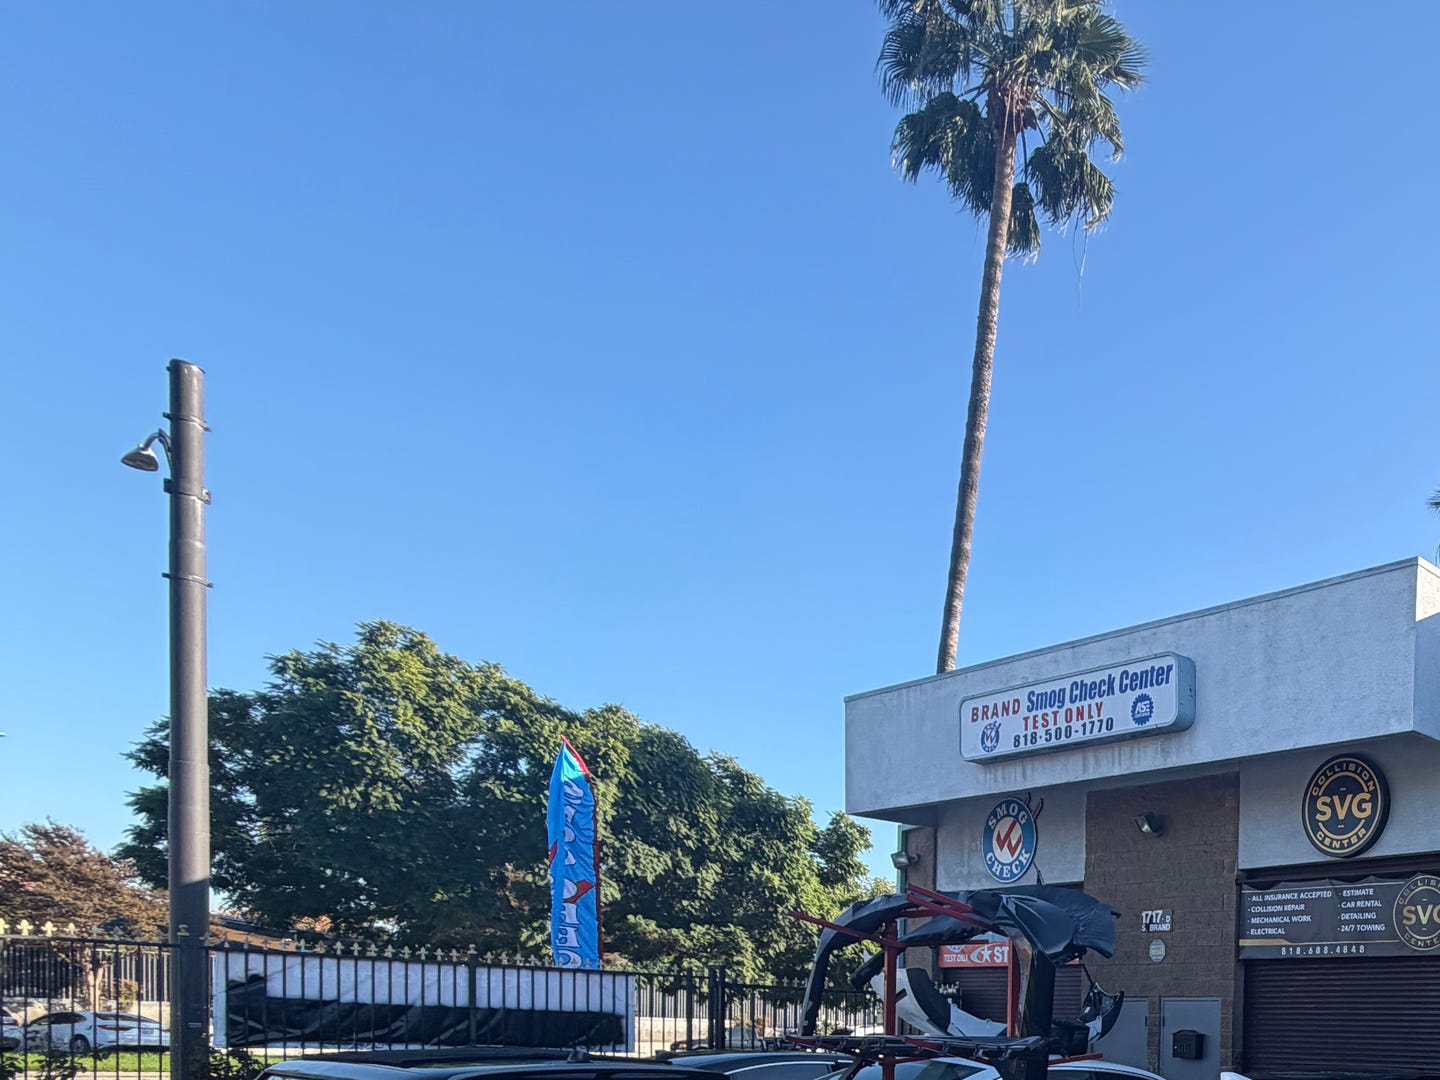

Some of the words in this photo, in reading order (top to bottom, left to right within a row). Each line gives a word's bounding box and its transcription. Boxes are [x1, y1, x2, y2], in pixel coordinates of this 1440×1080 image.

[971, 698, 1021, 723] BRAND
[1026, 687, 1067, 713] Smog
[1069, 673, 1116, 704] Check
[1119, 664, 1174, 694] Center
[1135, 700, 1151, 714] ASE
[1023, 710, 1060, 732] TEST
[1064, 701, 1104, 724] ONLY
[1312, 762, 1375, 796] COLLISION
[1315, 792, 1372, 821] SVG
[988, 803, 1028, 829] SMOG
[1316, 828, 1366, 848] CENTER
[986, 848, 1031, 877] CHECK
[1264, 893, 1299, 901] INSURANCE
[1300, 891, 1332, 899] ACCEPTED
[1343, 888, 1374, 896] ESTIMATE
[1251, 905, 1283, 913] COLLISION
[1341, 912, 1377, 920] DETAILING
[1149, 923, 1171, 931] BRAND
[1251, 916, 1291, 924] MECHANICAL
[994, 946, 1009, 963] ST
